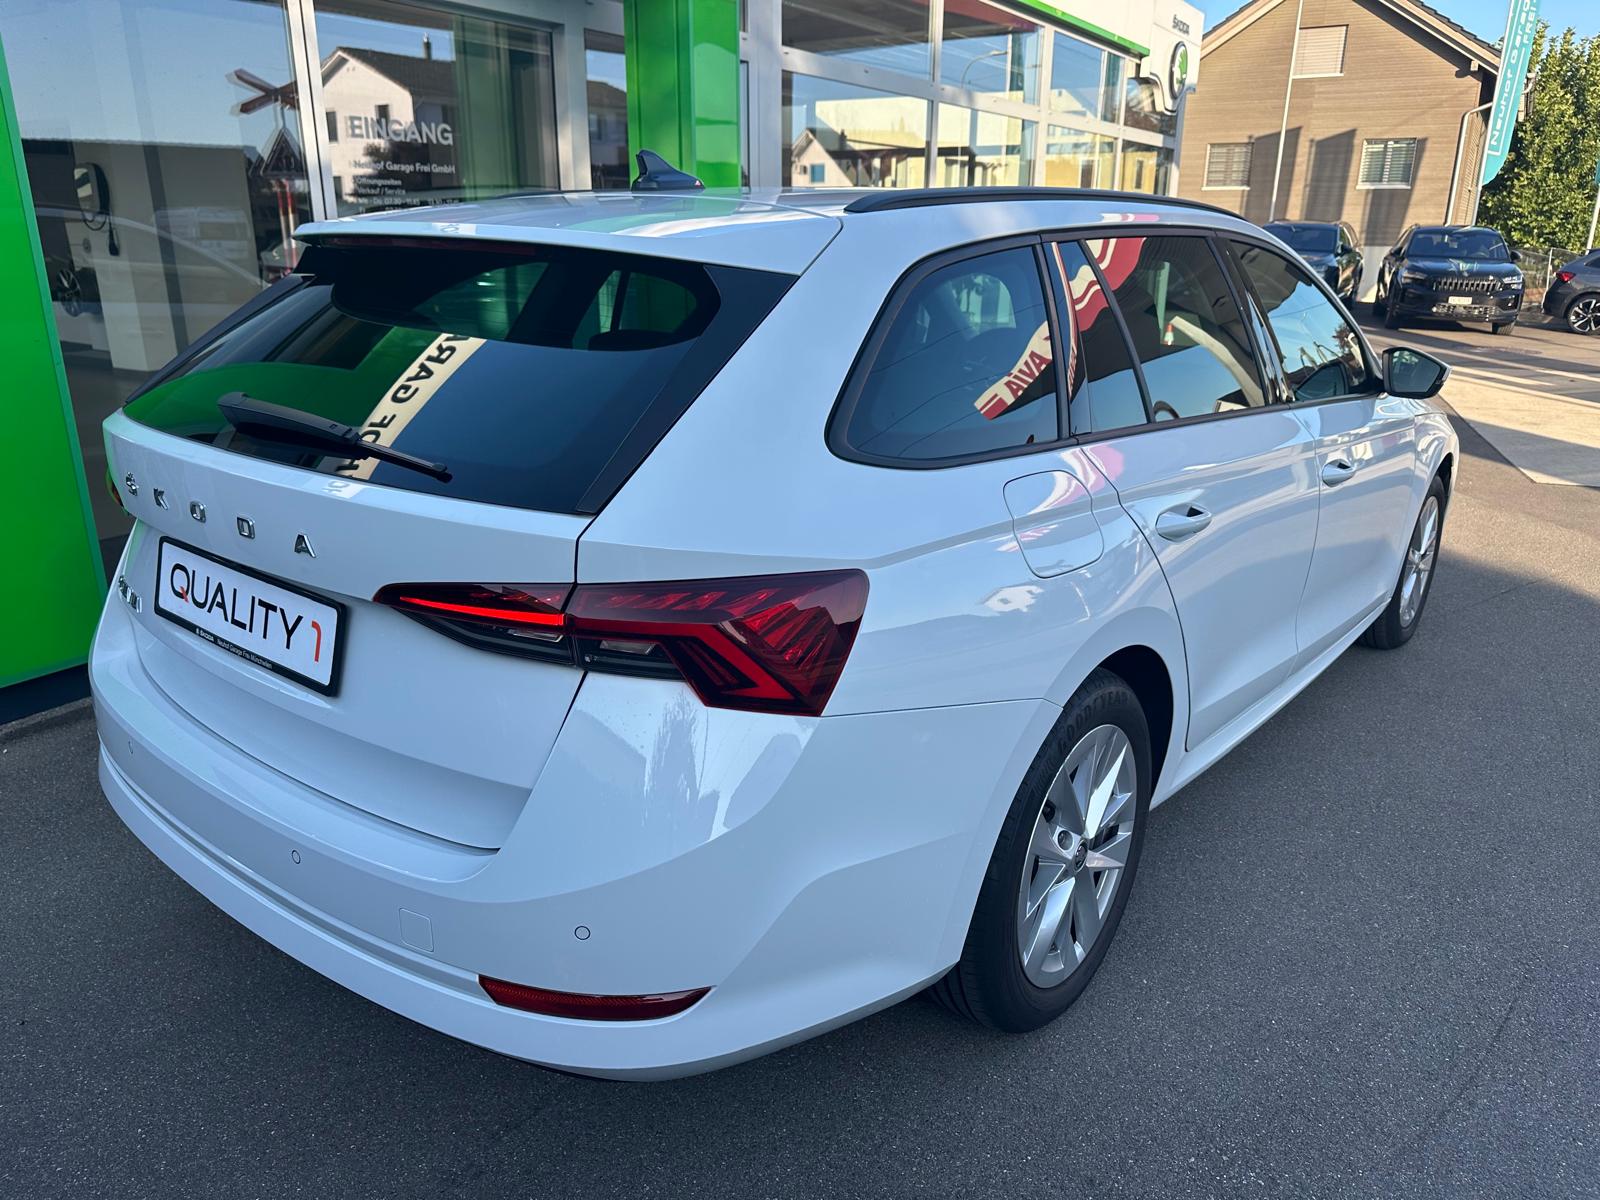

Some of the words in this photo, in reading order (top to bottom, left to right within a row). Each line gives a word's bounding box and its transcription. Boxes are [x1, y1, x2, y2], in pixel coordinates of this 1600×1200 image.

[1523, 6, 1537, 44] FREI
[1491, 70, 1512, 145] Neuhof
[350, 115, 453, 146] EINGANG
[385, 161, 414, 174] Garage
[415, 163, 431, 173] Frei
[431, 164, 456, 174] GmbH
[357, 187, 380, 195] Verkauf
[385, 188, 406, 196] Service
[170, 563, 304, 650] QUALITY
[1057, 690, 1129, 753] GOODYEAR
